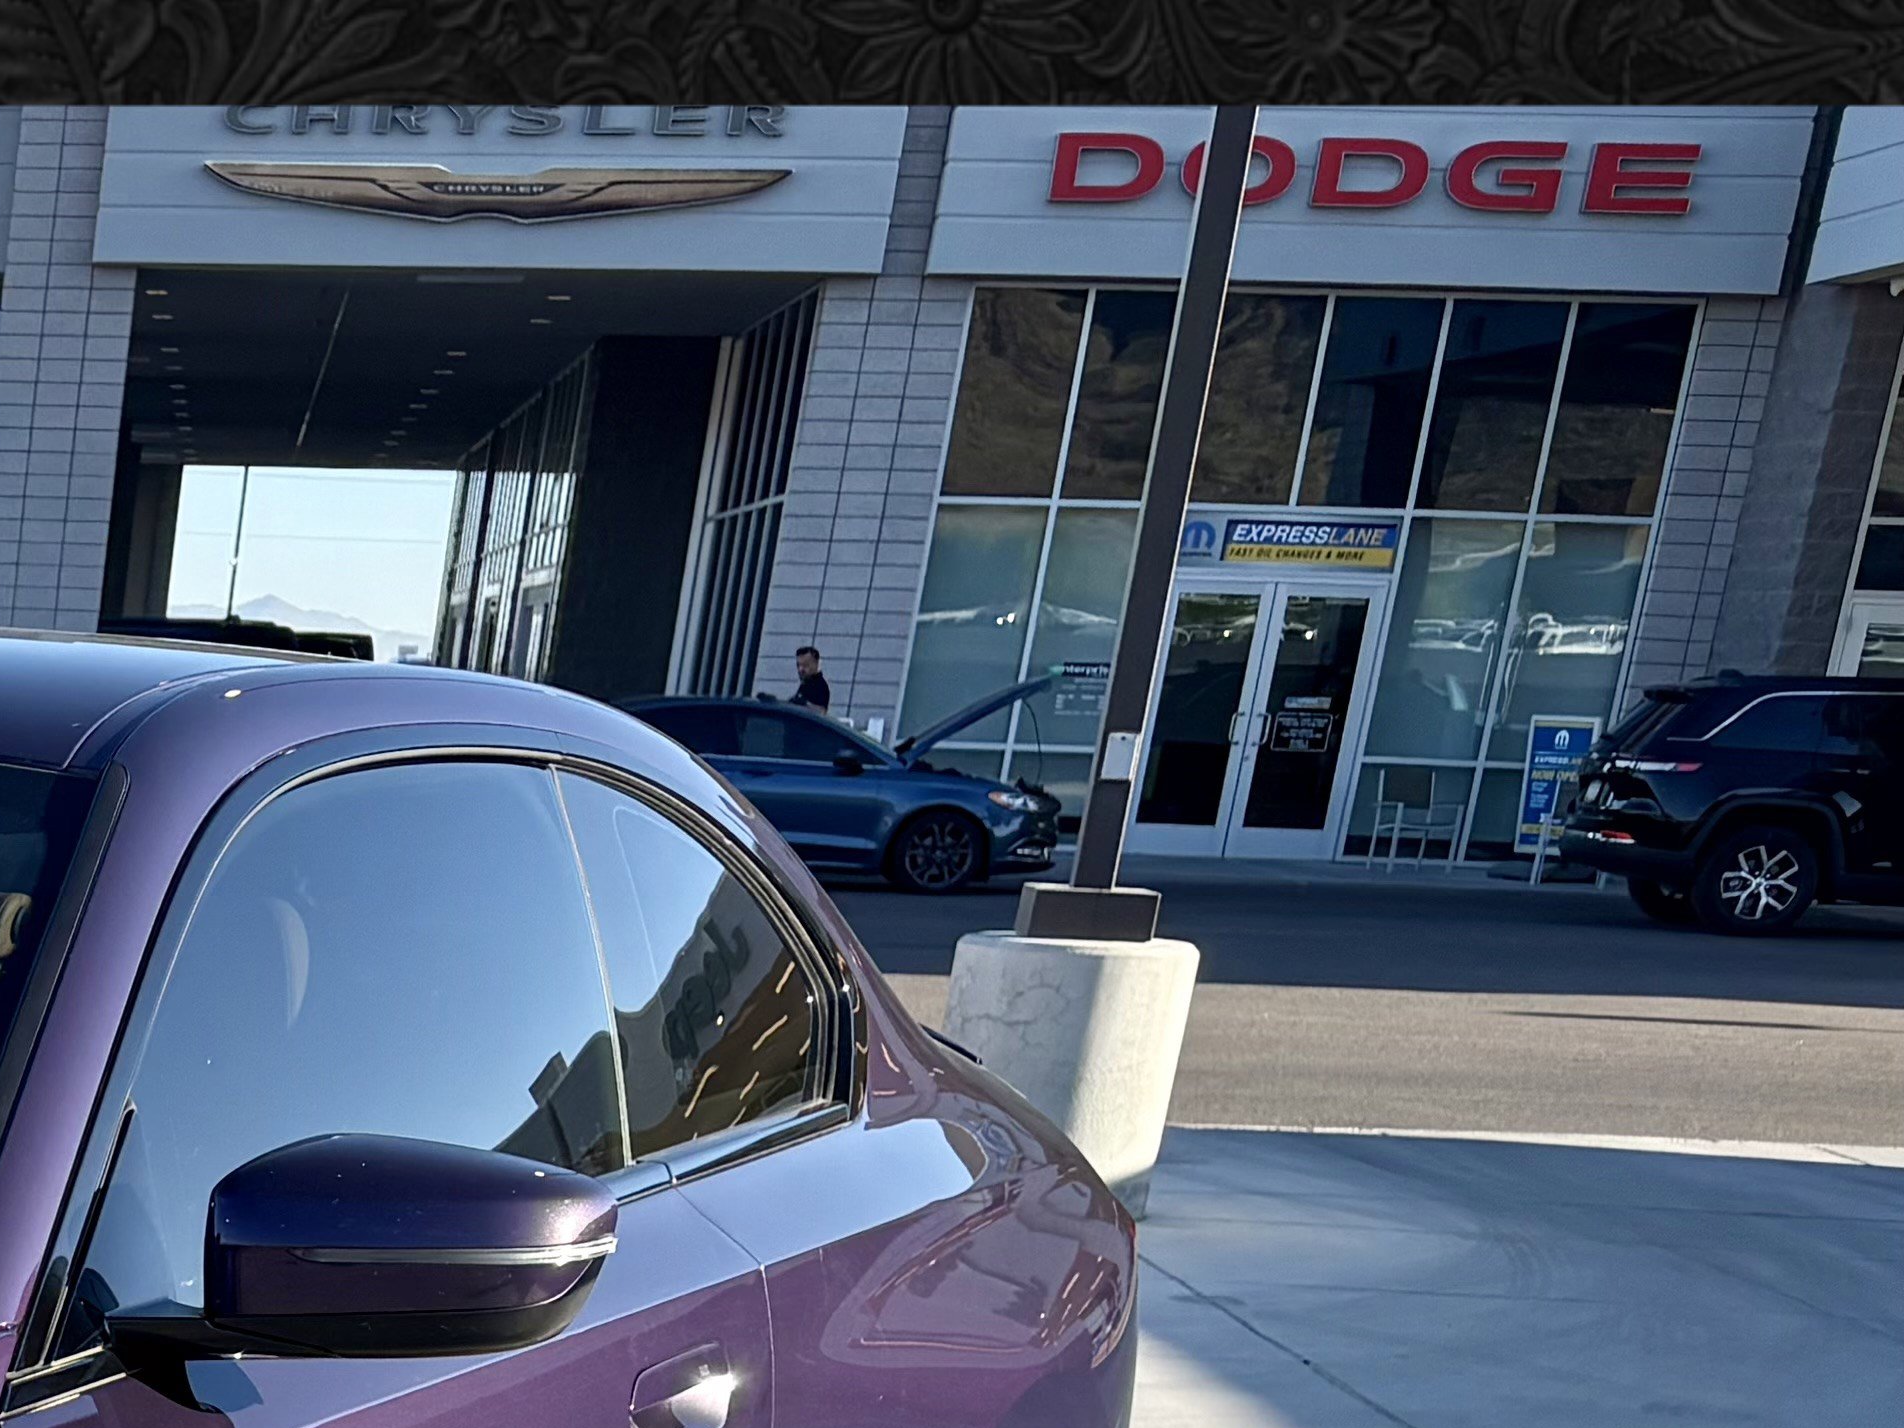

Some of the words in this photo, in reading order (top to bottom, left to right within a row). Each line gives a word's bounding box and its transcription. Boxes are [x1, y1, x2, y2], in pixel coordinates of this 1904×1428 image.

[223, 104, 786, 138] CHRYSLER
[1048, 131, 1702, 215] DODGE
[432, 182, 545, 195] CHRYSLER
[1232, 523, 1387, 546] EXPRESSLANE
